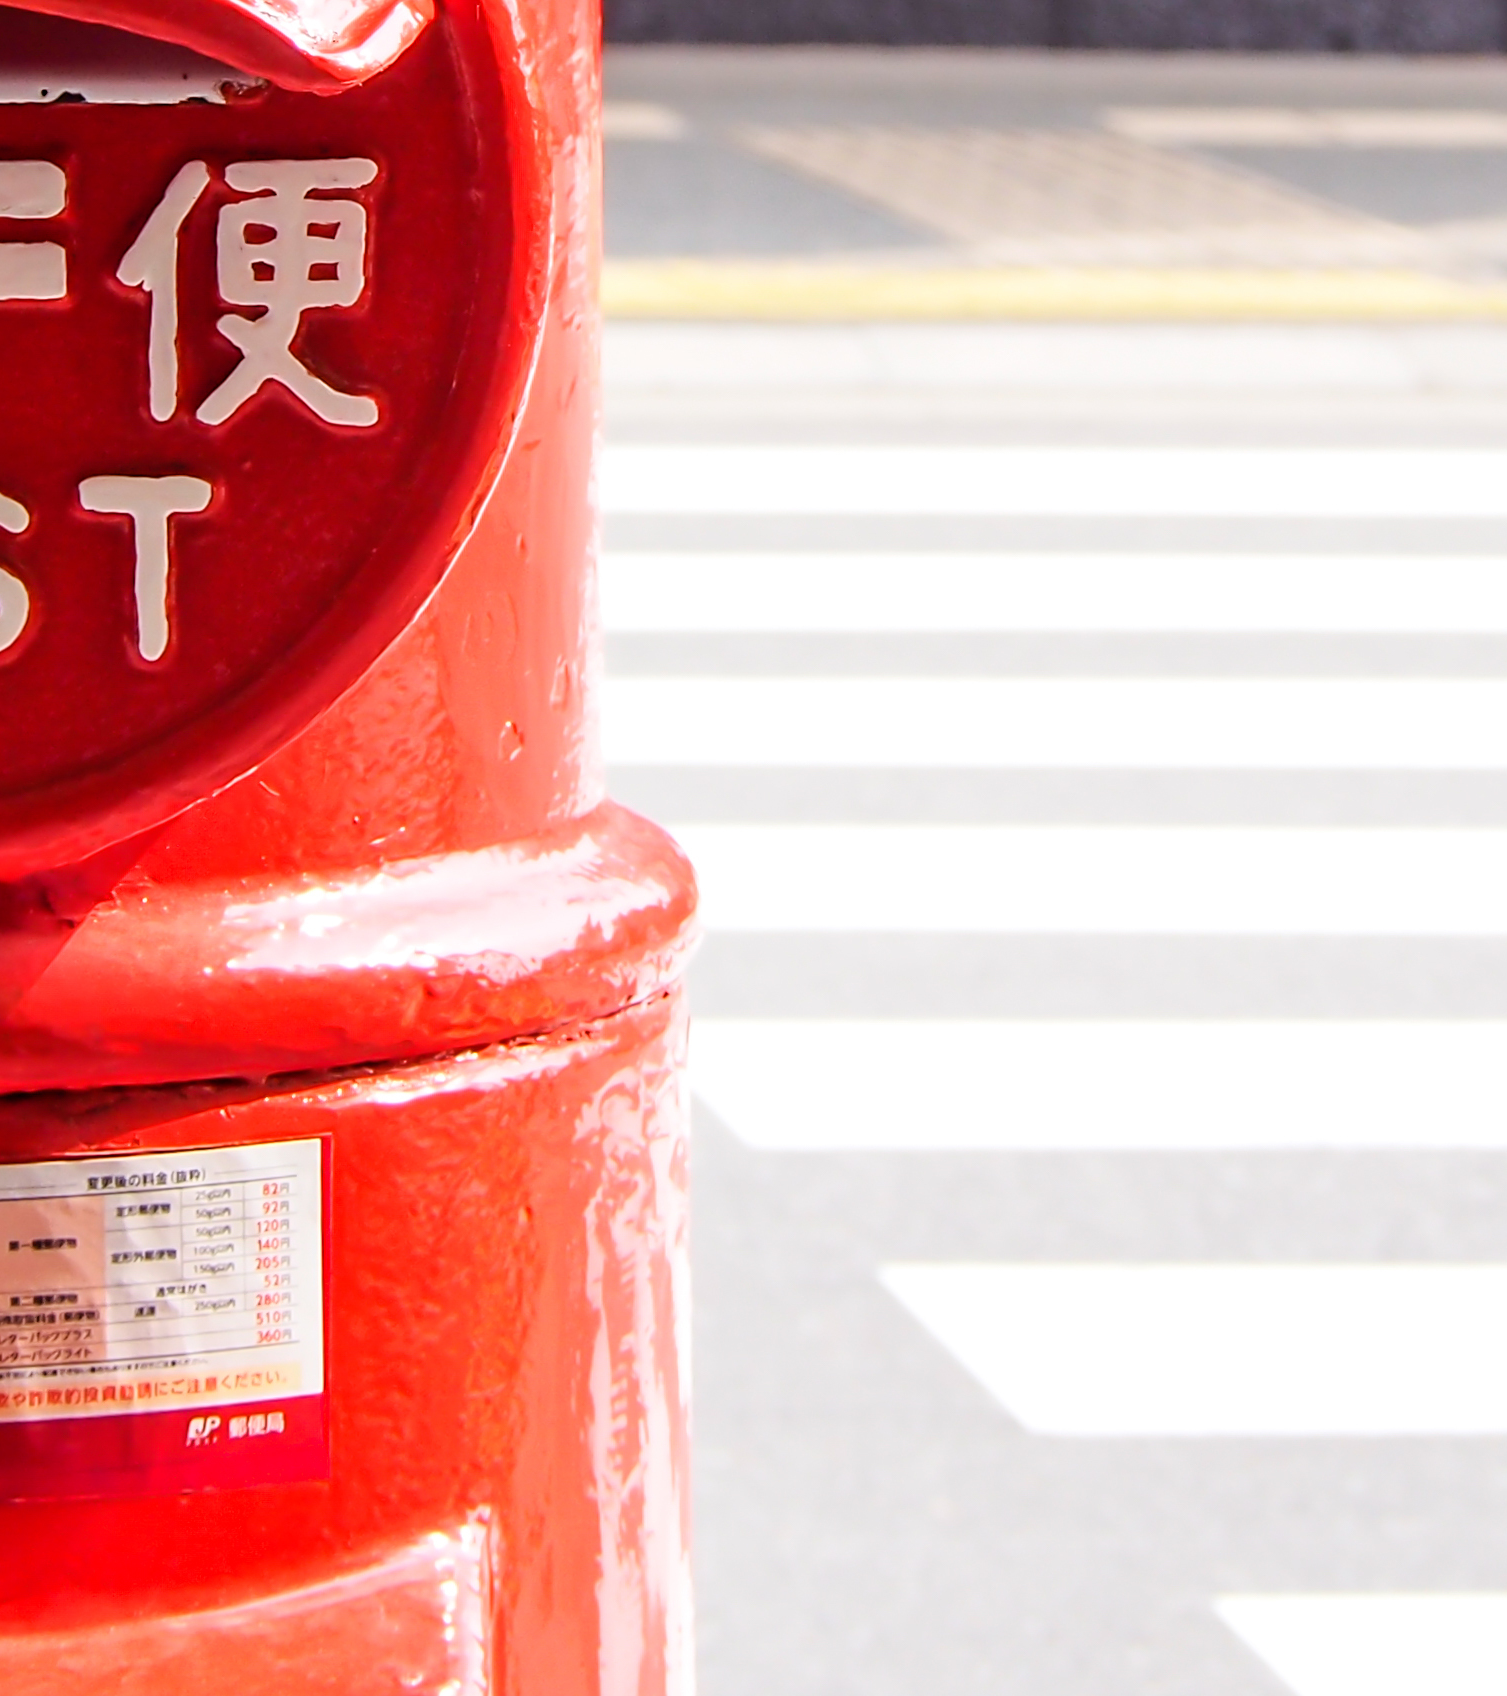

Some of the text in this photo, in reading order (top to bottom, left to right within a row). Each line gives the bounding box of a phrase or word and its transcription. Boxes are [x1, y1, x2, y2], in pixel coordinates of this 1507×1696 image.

[262, 1182, 290, 1196] 82円
[263, 1200, 290, 1214] 92円
[256, 1219, 290, 1233] 120円
[257, 1237, 290, 1251] 140円
[255, 1256, 290, 1270] 205円
[264, 1274, 291, 1287] 52円
[256, 1292, 291, 1306] 280円
[256, 1310, 291, 1325] 510円
[256, 1328, 292, 1344] 360円
